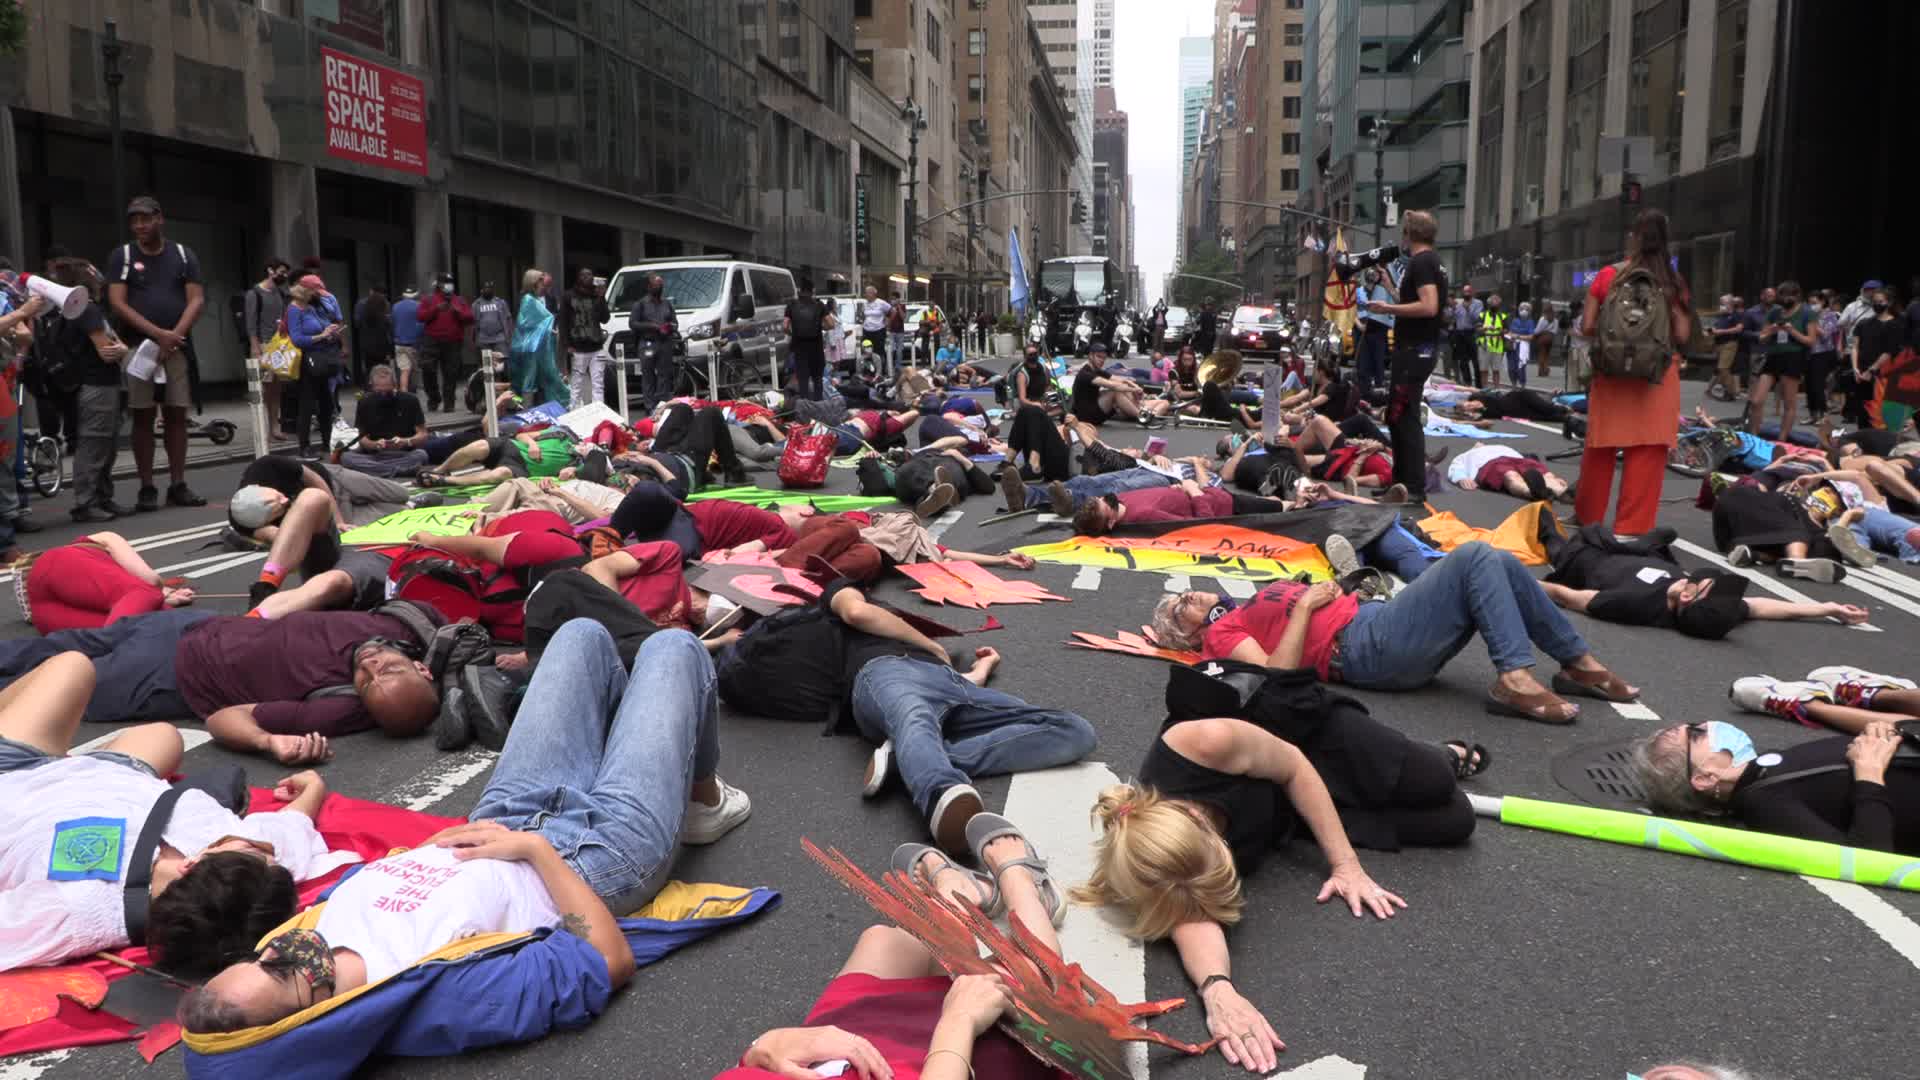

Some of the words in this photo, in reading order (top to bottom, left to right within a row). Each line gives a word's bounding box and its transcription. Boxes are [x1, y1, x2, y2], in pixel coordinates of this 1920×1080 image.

[325, 55, 384, 102] RETAIL
[328, 90, 386, 136] SPACE
[330, 127, 388, 159] AVAILABLE
[857, 188, 865, 243] MARKET
[364, 862, 447, 888] FUCKING
[391, 857, 461, 879] PLANET
[373, 895, 421, 913] SAVE
[395, 884, 432, 900] THE
